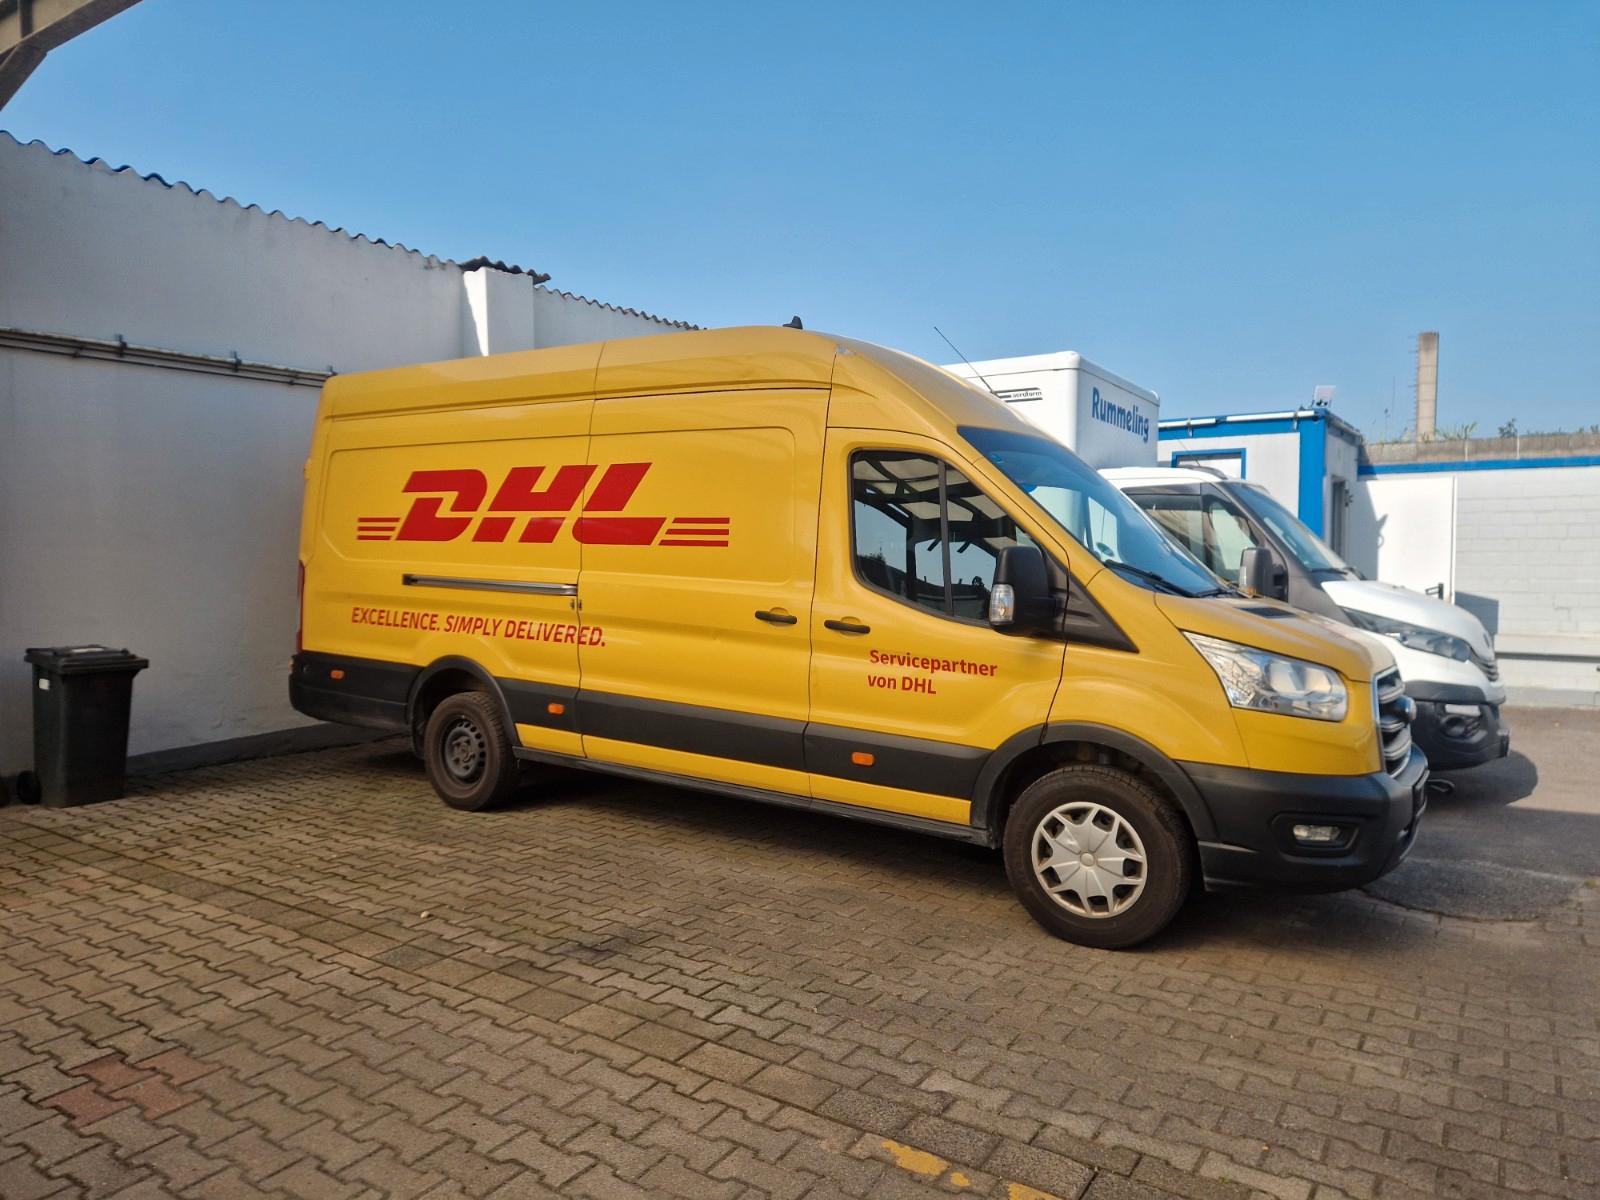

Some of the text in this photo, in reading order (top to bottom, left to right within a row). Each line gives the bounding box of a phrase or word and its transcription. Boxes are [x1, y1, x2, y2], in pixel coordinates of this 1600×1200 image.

[1091, 387, 1149, 442] Rummeling
[396, 462, 666, 546] DHL
[352, 607, 606, 647] EXCELLENCE. SIMPLY DELIVERED.
[869, 649, 998, 676] Servicepartner
[867, 675, 937, 695] von DHL
